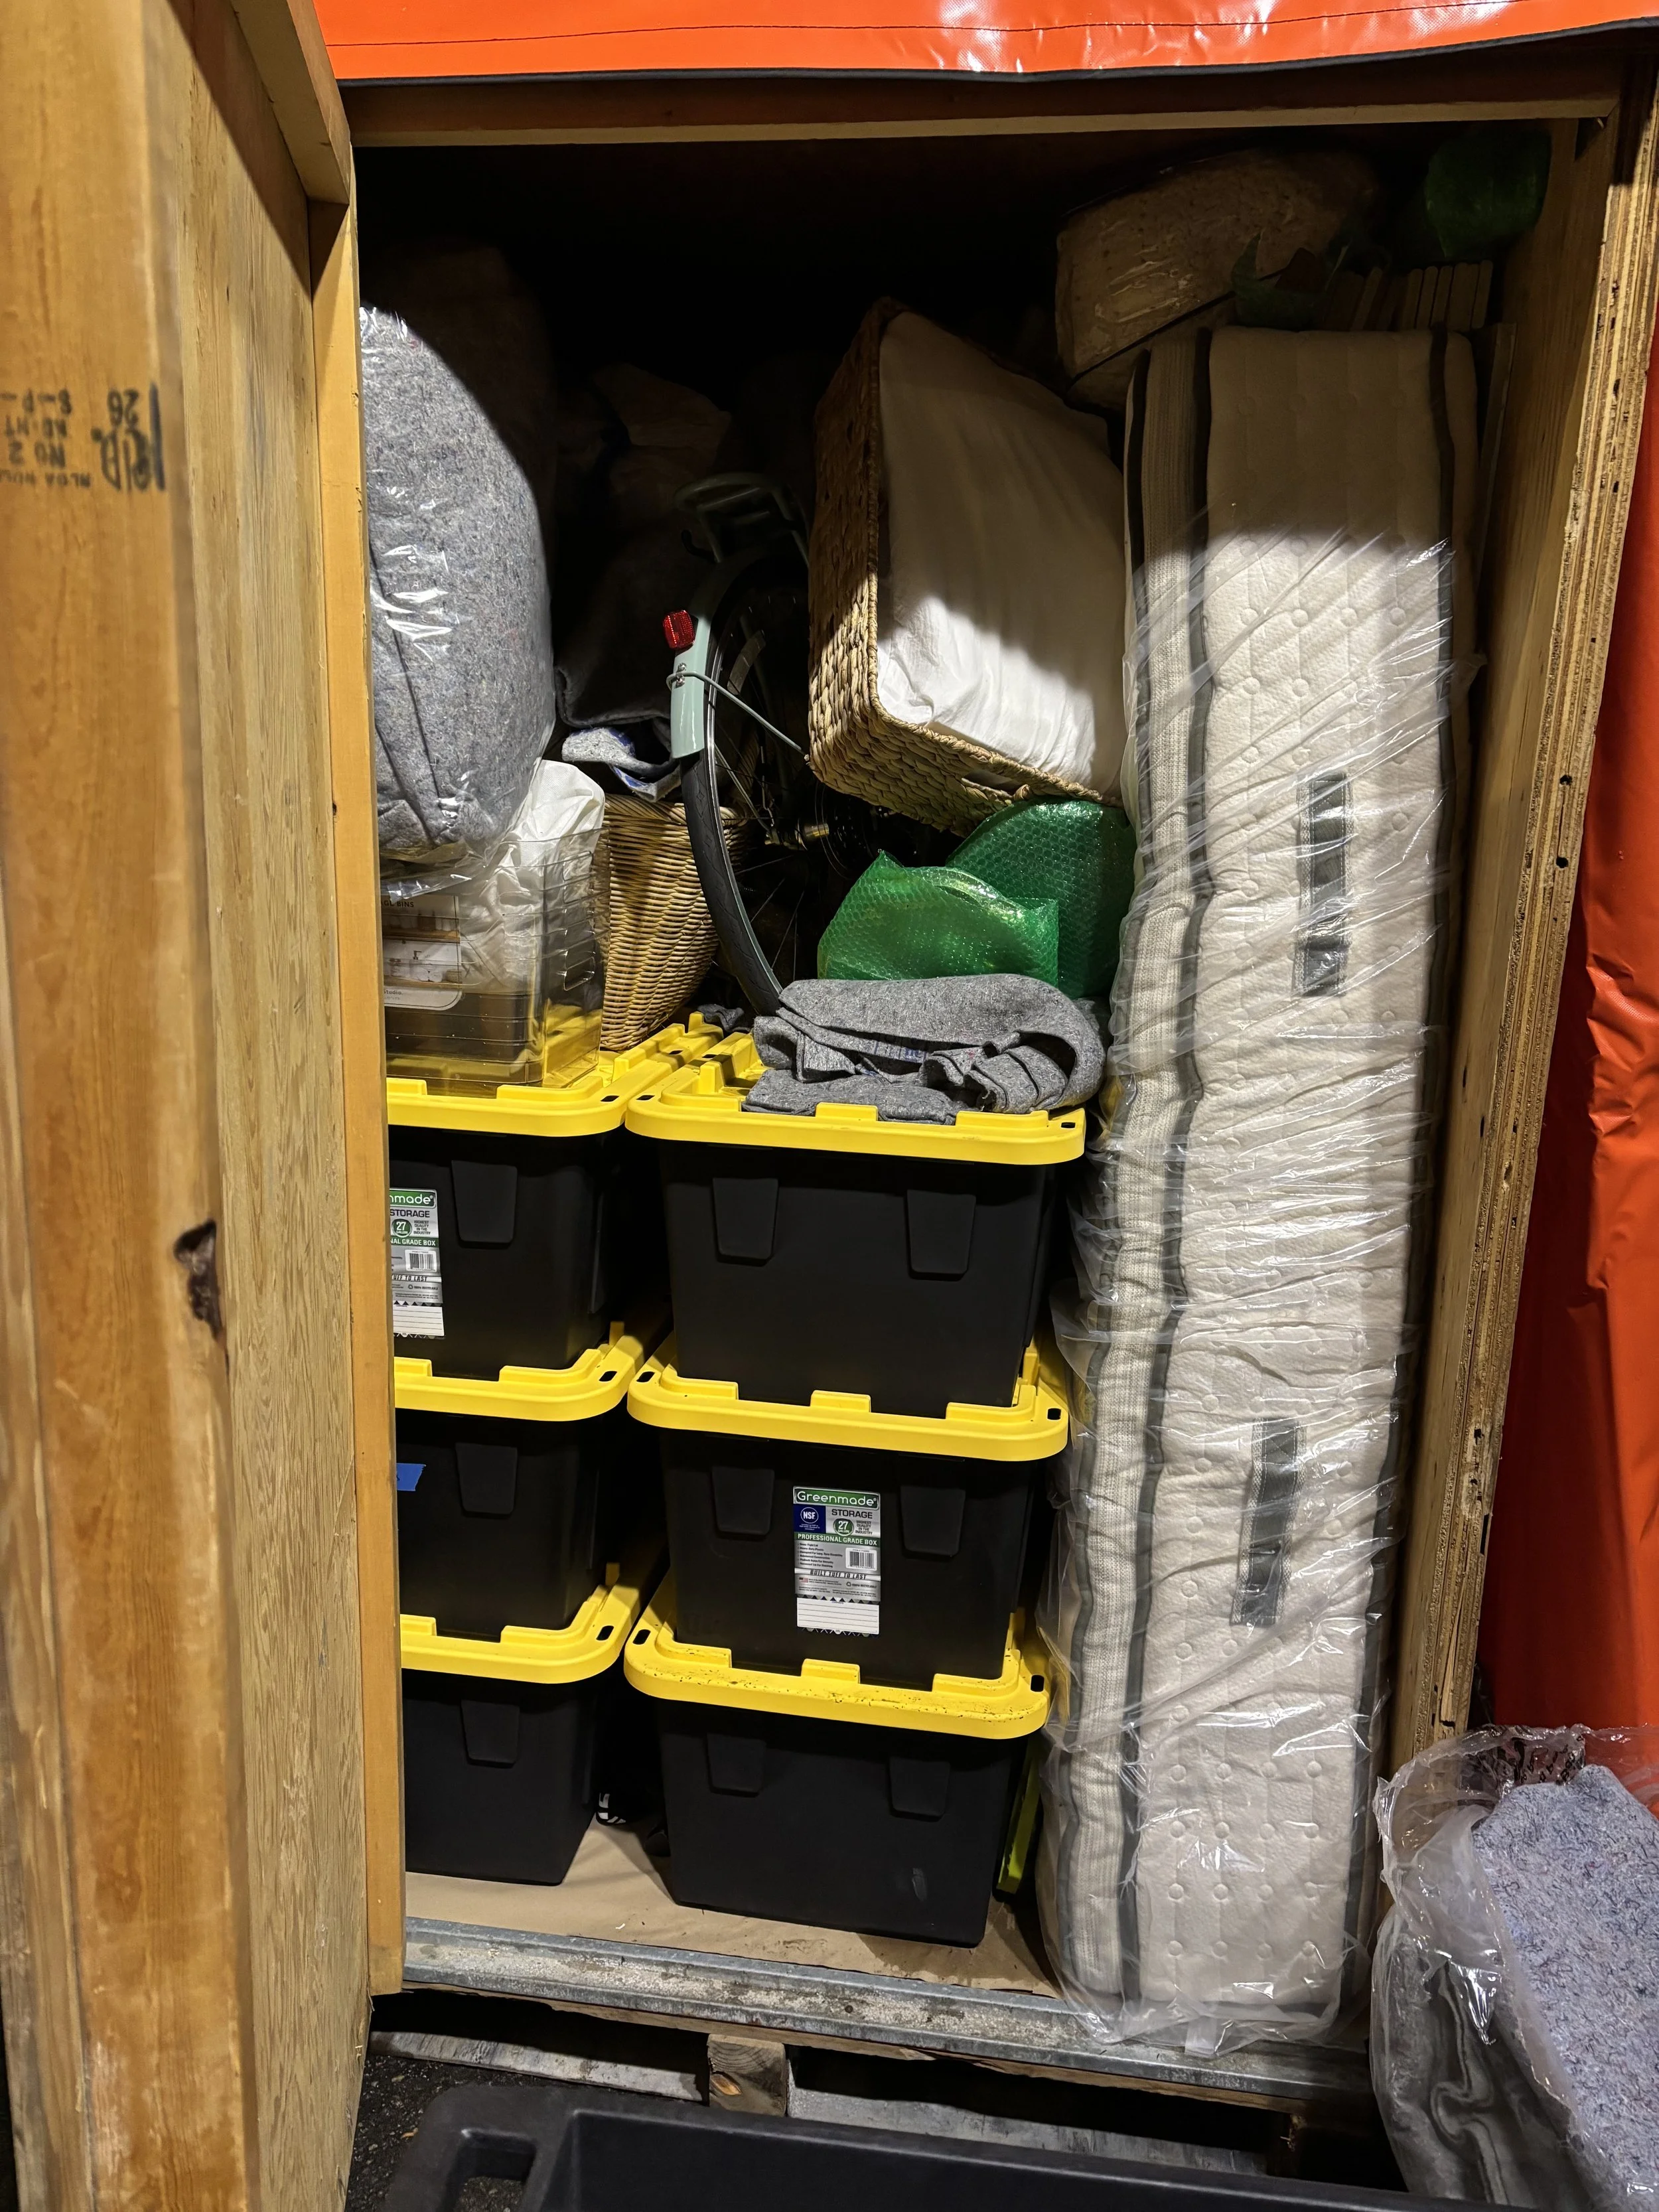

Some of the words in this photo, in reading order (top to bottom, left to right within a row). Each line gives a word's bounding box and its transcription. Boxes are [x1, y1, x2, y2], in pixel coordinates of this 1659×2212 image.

[390, 1209, 430, 1218] STORAGE
[396, 1221, 407, 1231] 27
[797, 1491, 874, 1507] Greenmade
[803, 1511, 816, 1520] NSF
[831, 1509, 873, 1519] STORAGE
[838, 1520, 849, 1530] 27
[798, 1533, 842, 1542] PROFESSIONAL
